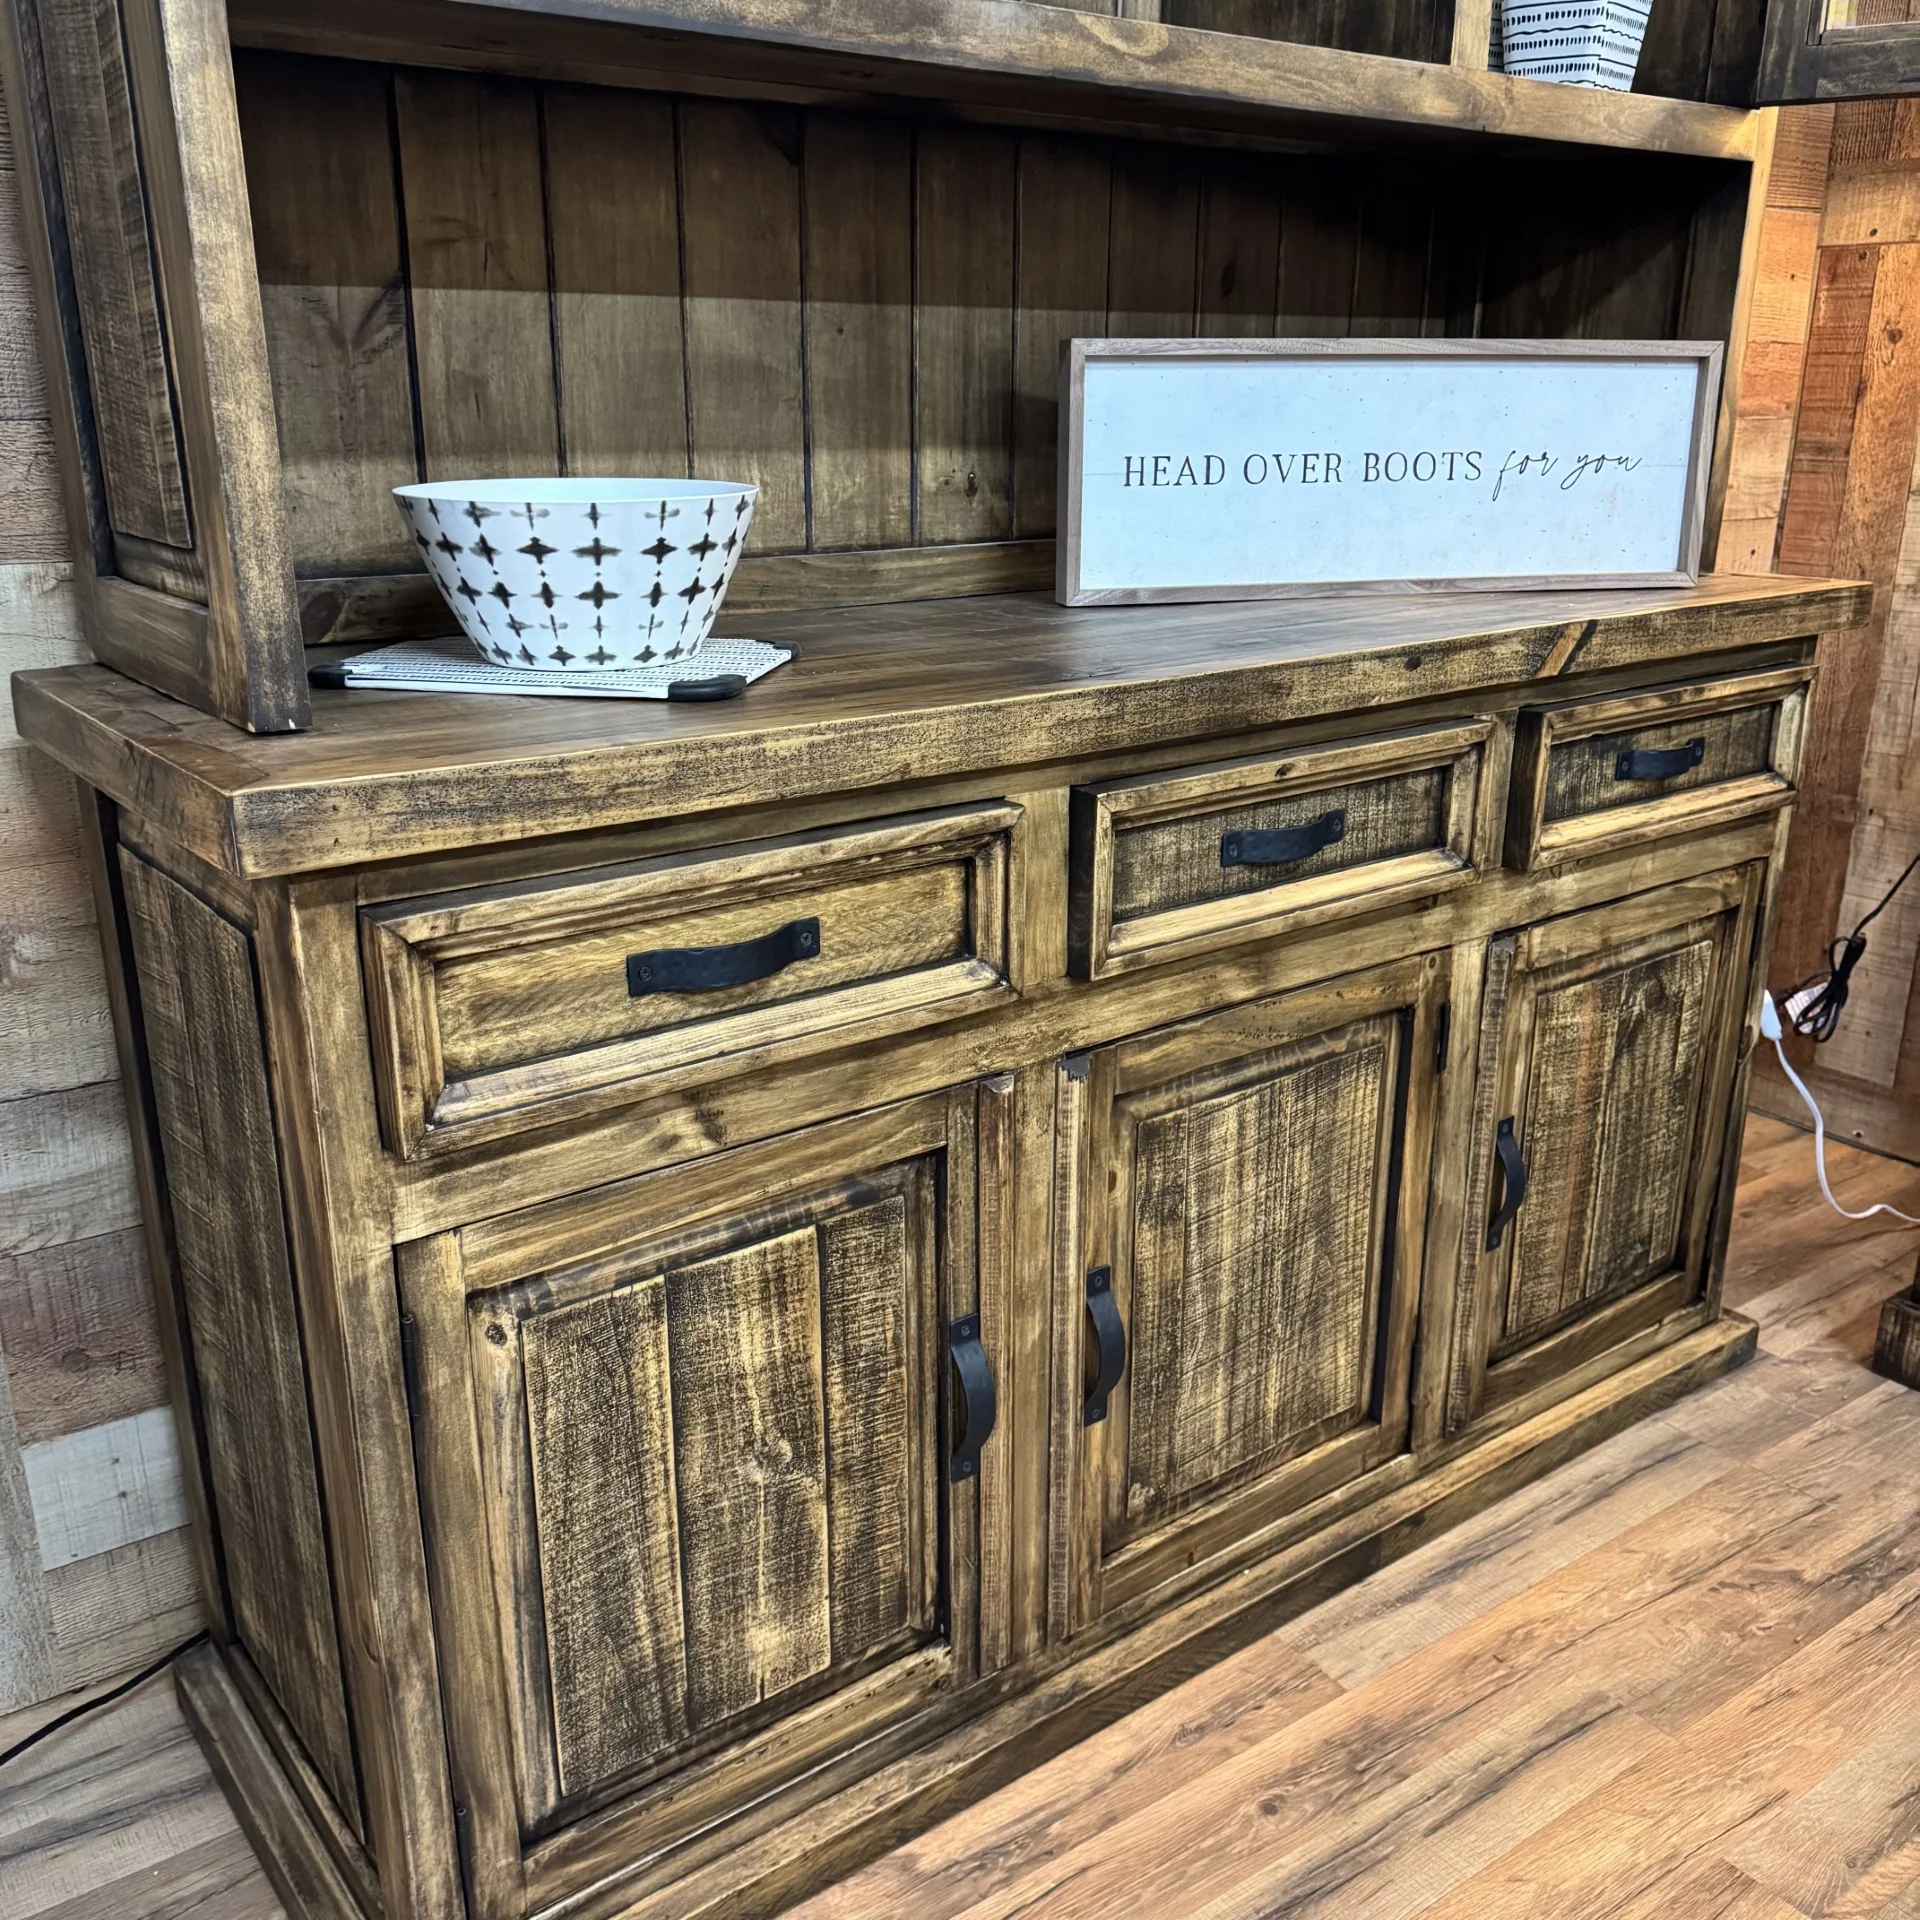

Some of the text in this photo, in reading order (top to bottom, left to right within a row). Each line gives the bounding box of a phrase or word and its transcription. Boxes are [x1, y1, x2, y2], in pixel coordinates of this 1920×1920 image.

[1123, 449, 1643, 502] HEAD OVER BOOTS for you
